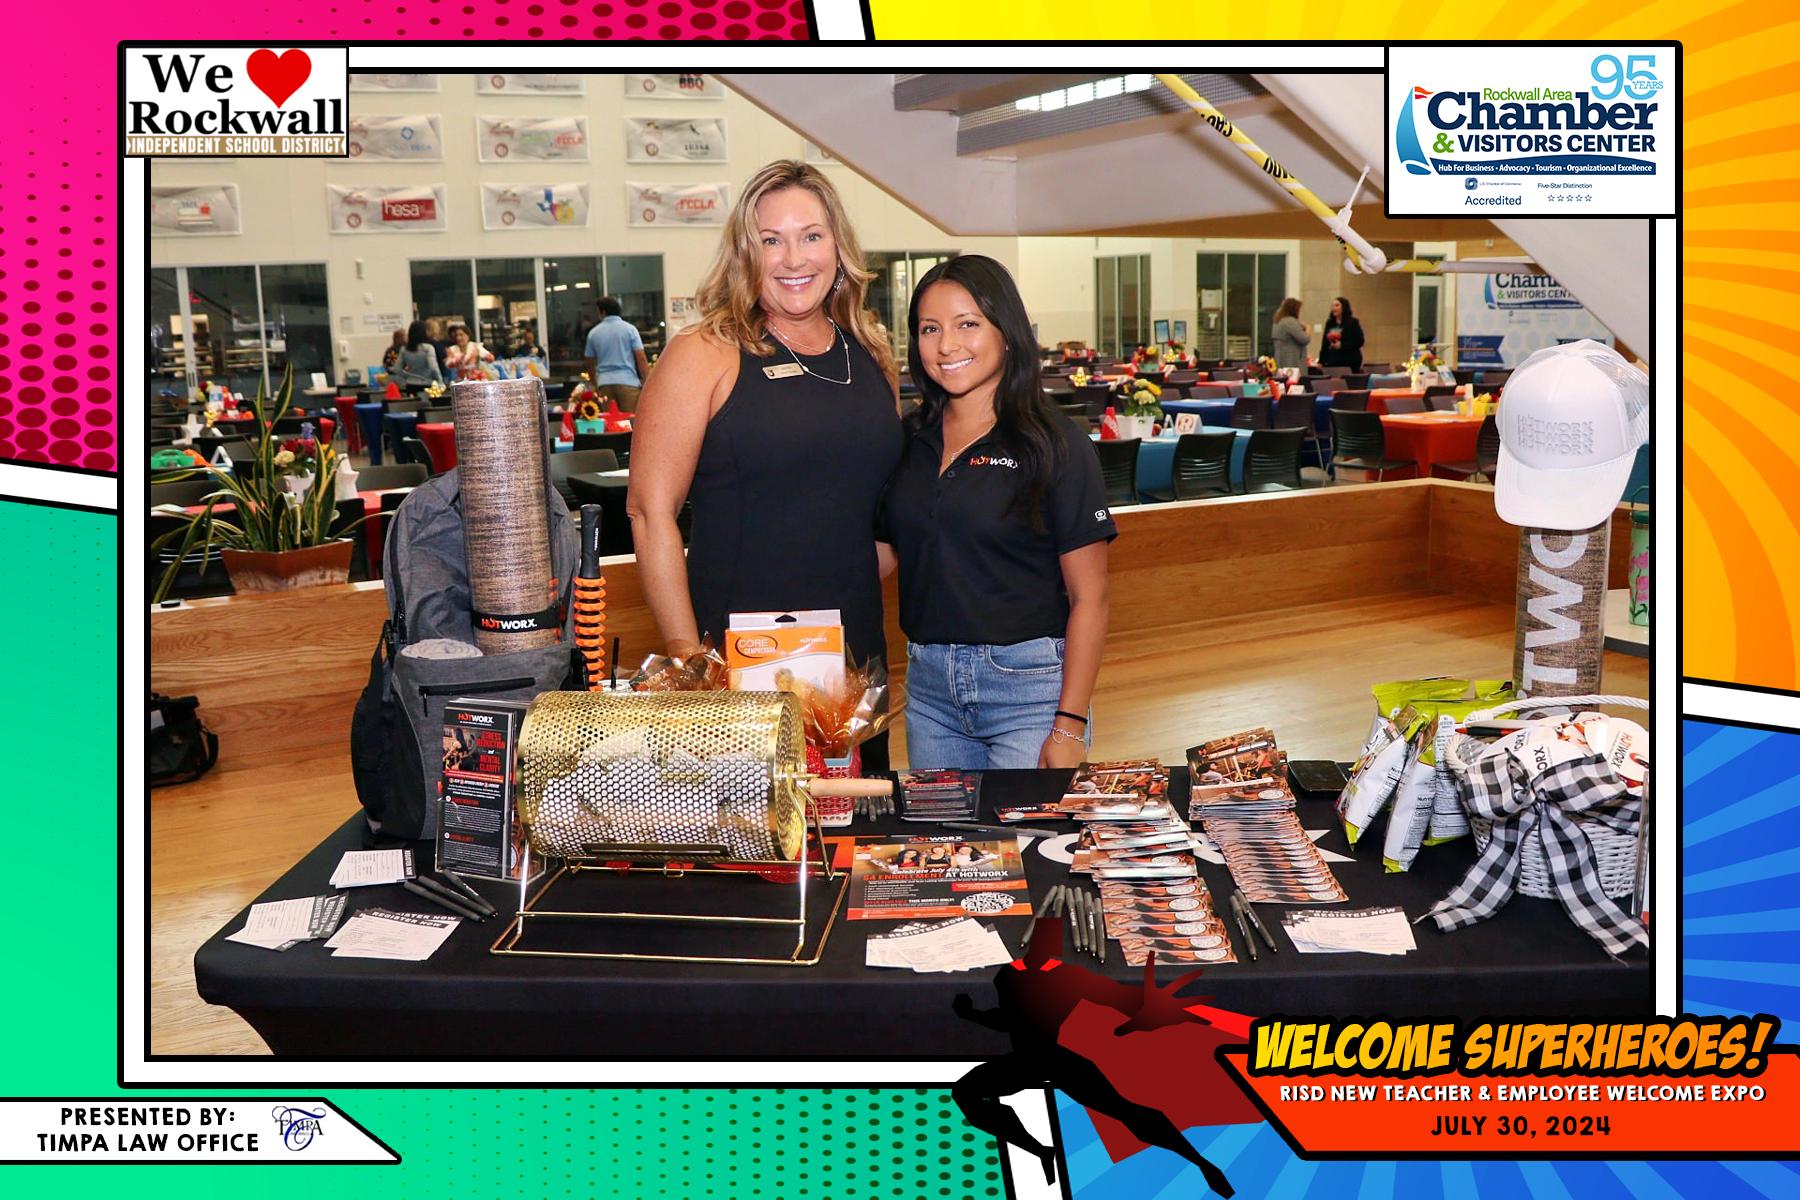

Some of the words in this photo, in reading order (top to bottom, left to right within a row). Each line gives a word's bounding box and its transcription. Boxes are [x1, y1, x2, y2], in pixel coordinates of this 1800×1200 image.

[1200, 113, 1233, 138] CAU
[1495, 273, 1561, 288] Cham
[1507, 289, 1546, 299] VISITORS
[481, 617, 538, 630] HOTWORX
[457, 713, 494, 724] HOTWORX
[930, 867, 945, 875] July
[960, 870, 1008, 878] HOTWORX
[372, 911, 417, 924] REGISTER
[420, 920, 442, 928] NOW
[888, 924, 939, 938] REGISTER
[941, 916, 964, 927] NOW
